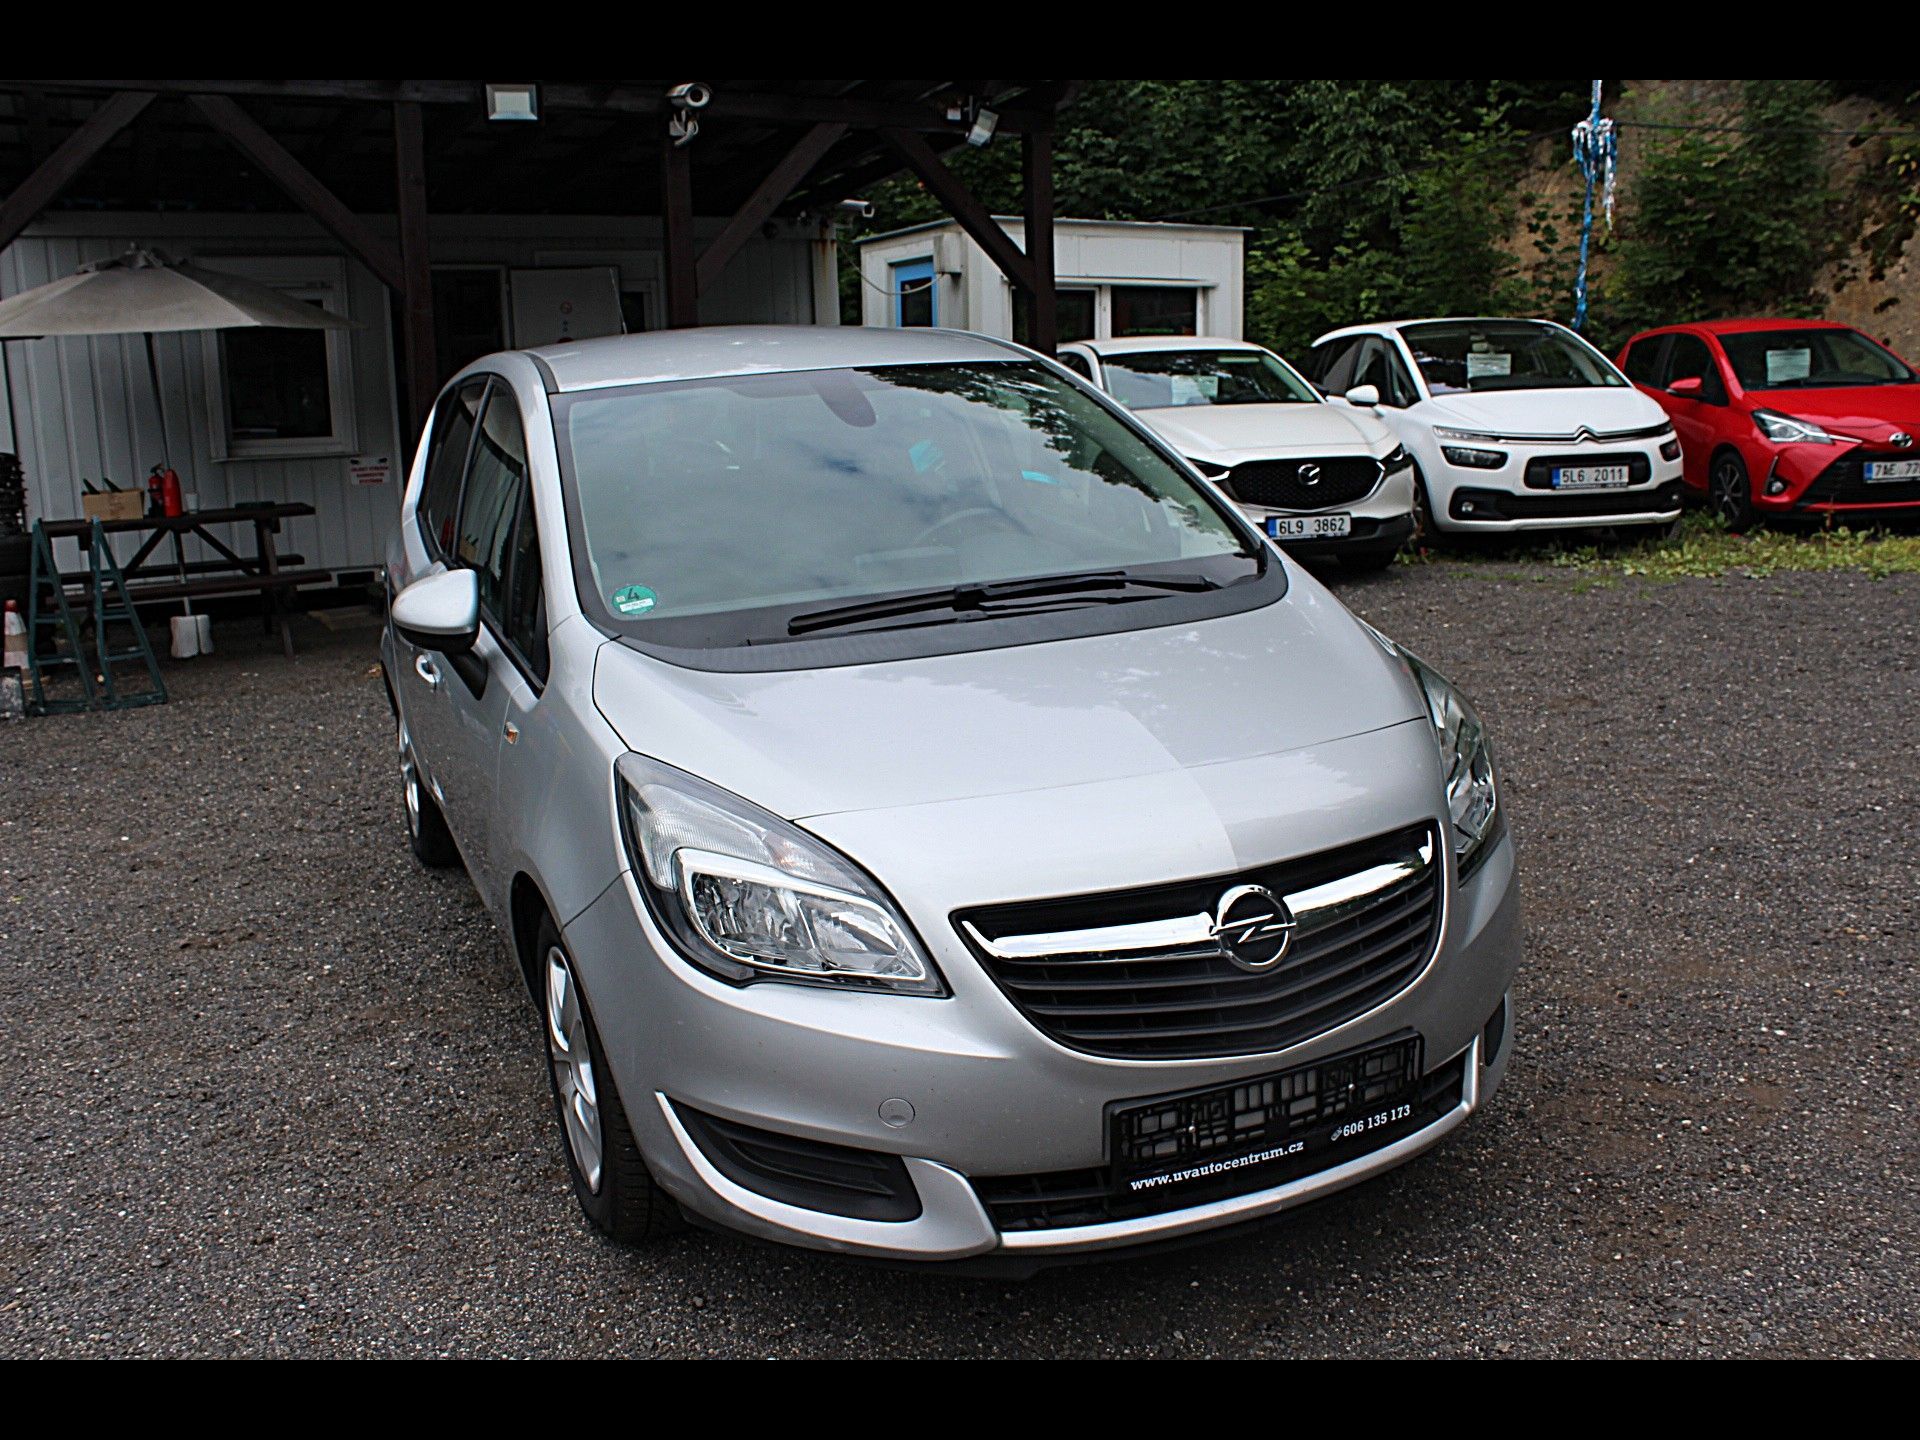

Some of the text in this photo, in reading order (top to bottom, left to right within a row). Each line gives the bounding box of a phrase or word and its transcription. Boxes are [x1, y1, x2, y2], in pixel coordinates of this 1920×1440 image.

[1562, 468, 1623, 483] 5L6 2011
[1875, 461, 1920, 477] 7AE 77
[1279, 520, 1304, 535] 6L9
[1314, 517, 1345, 533] 3862
[1130, 1104, 1411, 1191] www.uvautocentrum.cz 606 135 173
